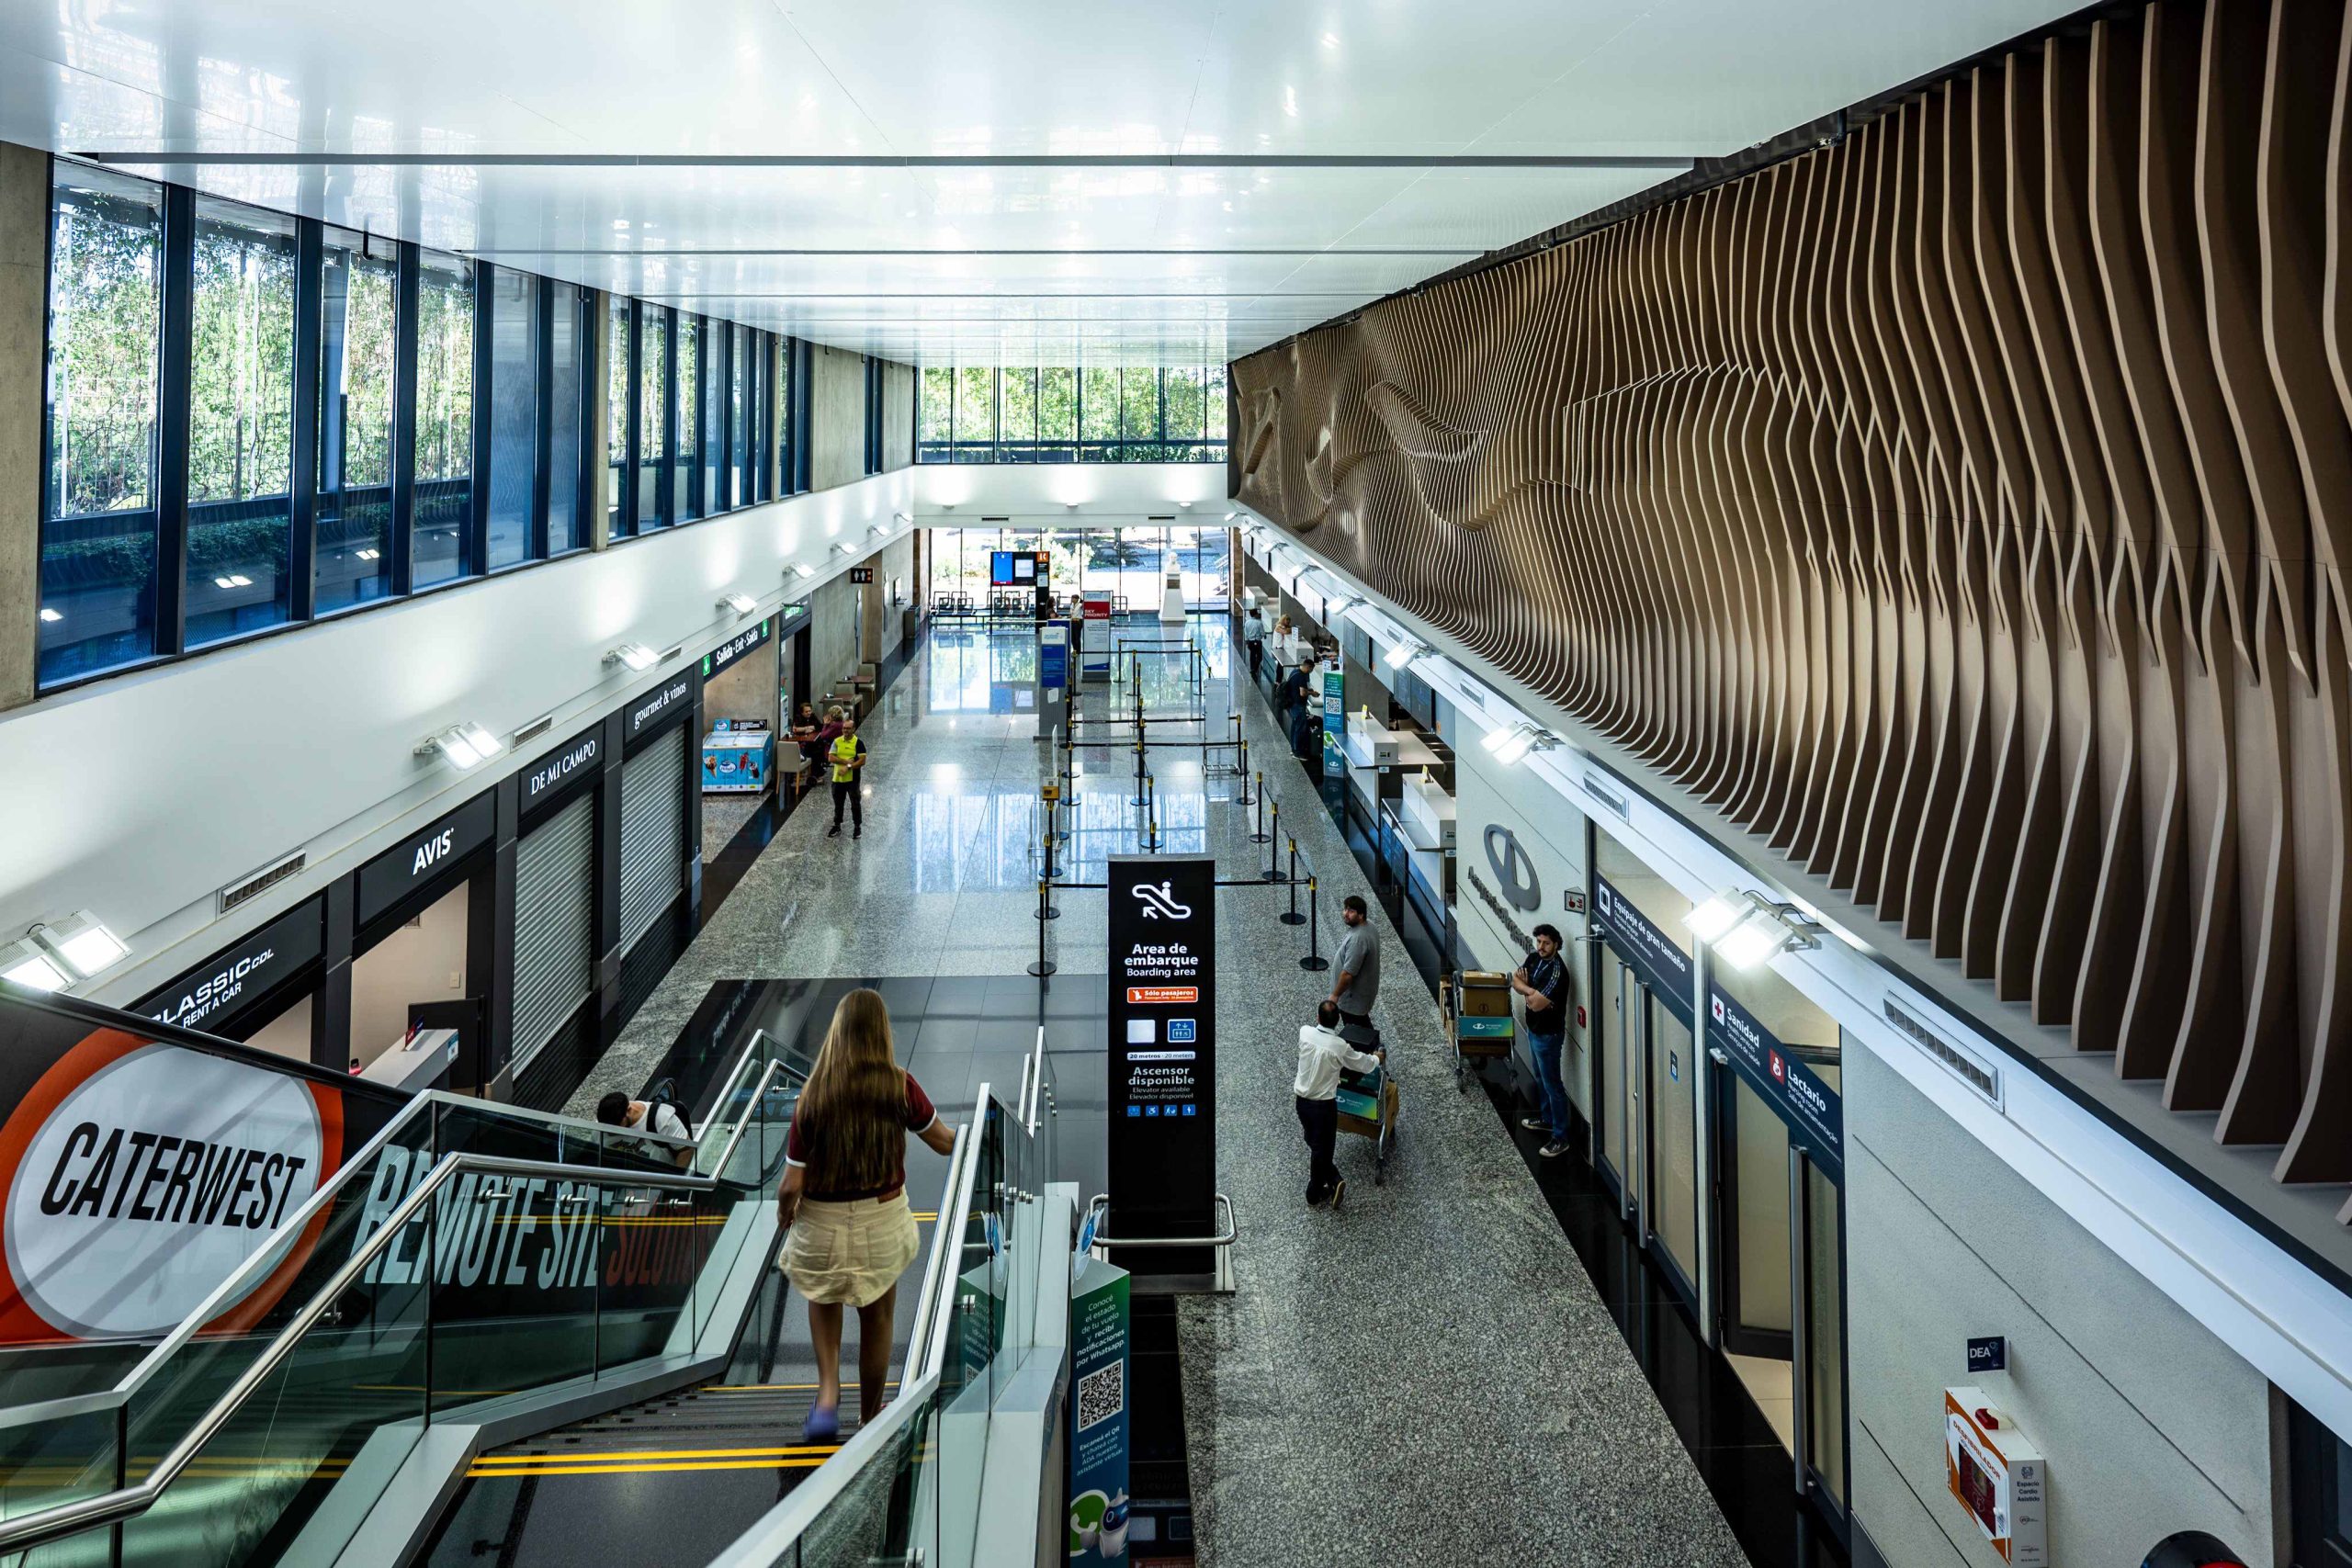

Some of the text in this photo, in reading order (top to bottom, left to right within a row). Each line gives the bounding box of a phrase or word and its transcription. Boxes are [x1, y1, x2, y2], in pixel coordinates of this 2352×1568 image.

[634, 682, 686, 730] gourmet & vinos
[530, 739, 596, 796] DE MI CAMPO
[413, 829, 452, 875] AVIS
[1613, 897, 1686, 973] Equipaje de gran tamaño
[251, 948, 275, 970] CDL
[1132, 942, 1188, 954] Area de
[1124, 954, 1199, 968] embarque
[1126, 967, 1171, 978] Boarding
[1160, 989, 1194, 998] pasajeros
[183, 981, 243, 1029] RENT A CAR
[1726, 1007, 1760, 1049] Sanidad
[1127, 1075, 1195, 1088] disponible
[1133, 1066, 1191, 1076] Ascensor
[1787, 1065, 1826, 1112] Lactario
[40, 1121, 307, 1231] CATERWEST
[349, 1144, 548, 1287] REMOTE
[537, 1177, 615, 1290] SITE
[1081, 1312, 1120, 1335] de tu vuelo
[1085, 1303, 1116, 1323] el estado
[1077, 1328, 1125, 1357] notificaciones
[1087, 1335, 1092, 1344] y
[1076, 1357, 1090, 1370] por
[1969, 1347, 1991, 1359] DEA
[1104, 1429, 1111, 1438] el
[1111, 1425, 1121, 1436] QR
